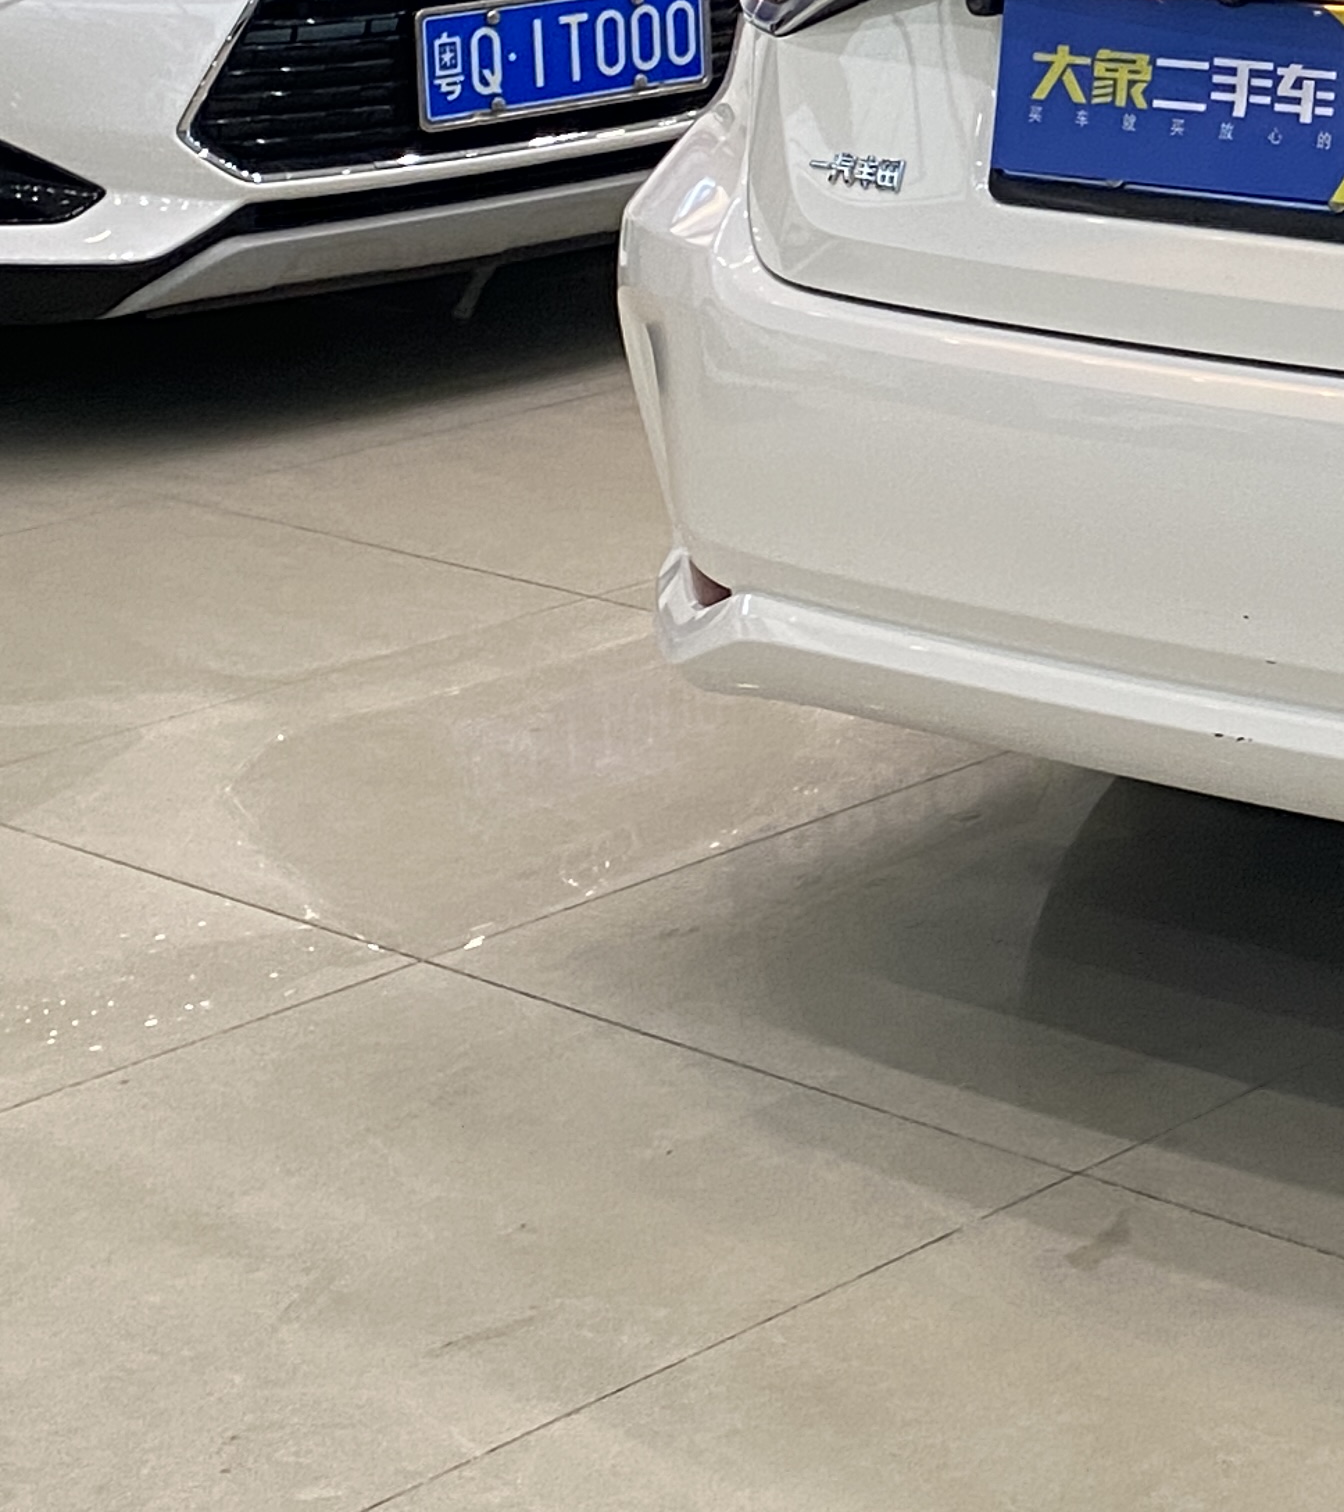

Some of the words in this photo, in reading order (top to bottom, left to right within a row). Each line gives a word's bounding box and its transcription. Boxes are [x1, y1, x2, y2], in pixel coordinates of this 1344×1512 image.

[1031, 44, 1338, 124] 大象二手车
[1028, 106, 1332, 150] 买车就买放心的
